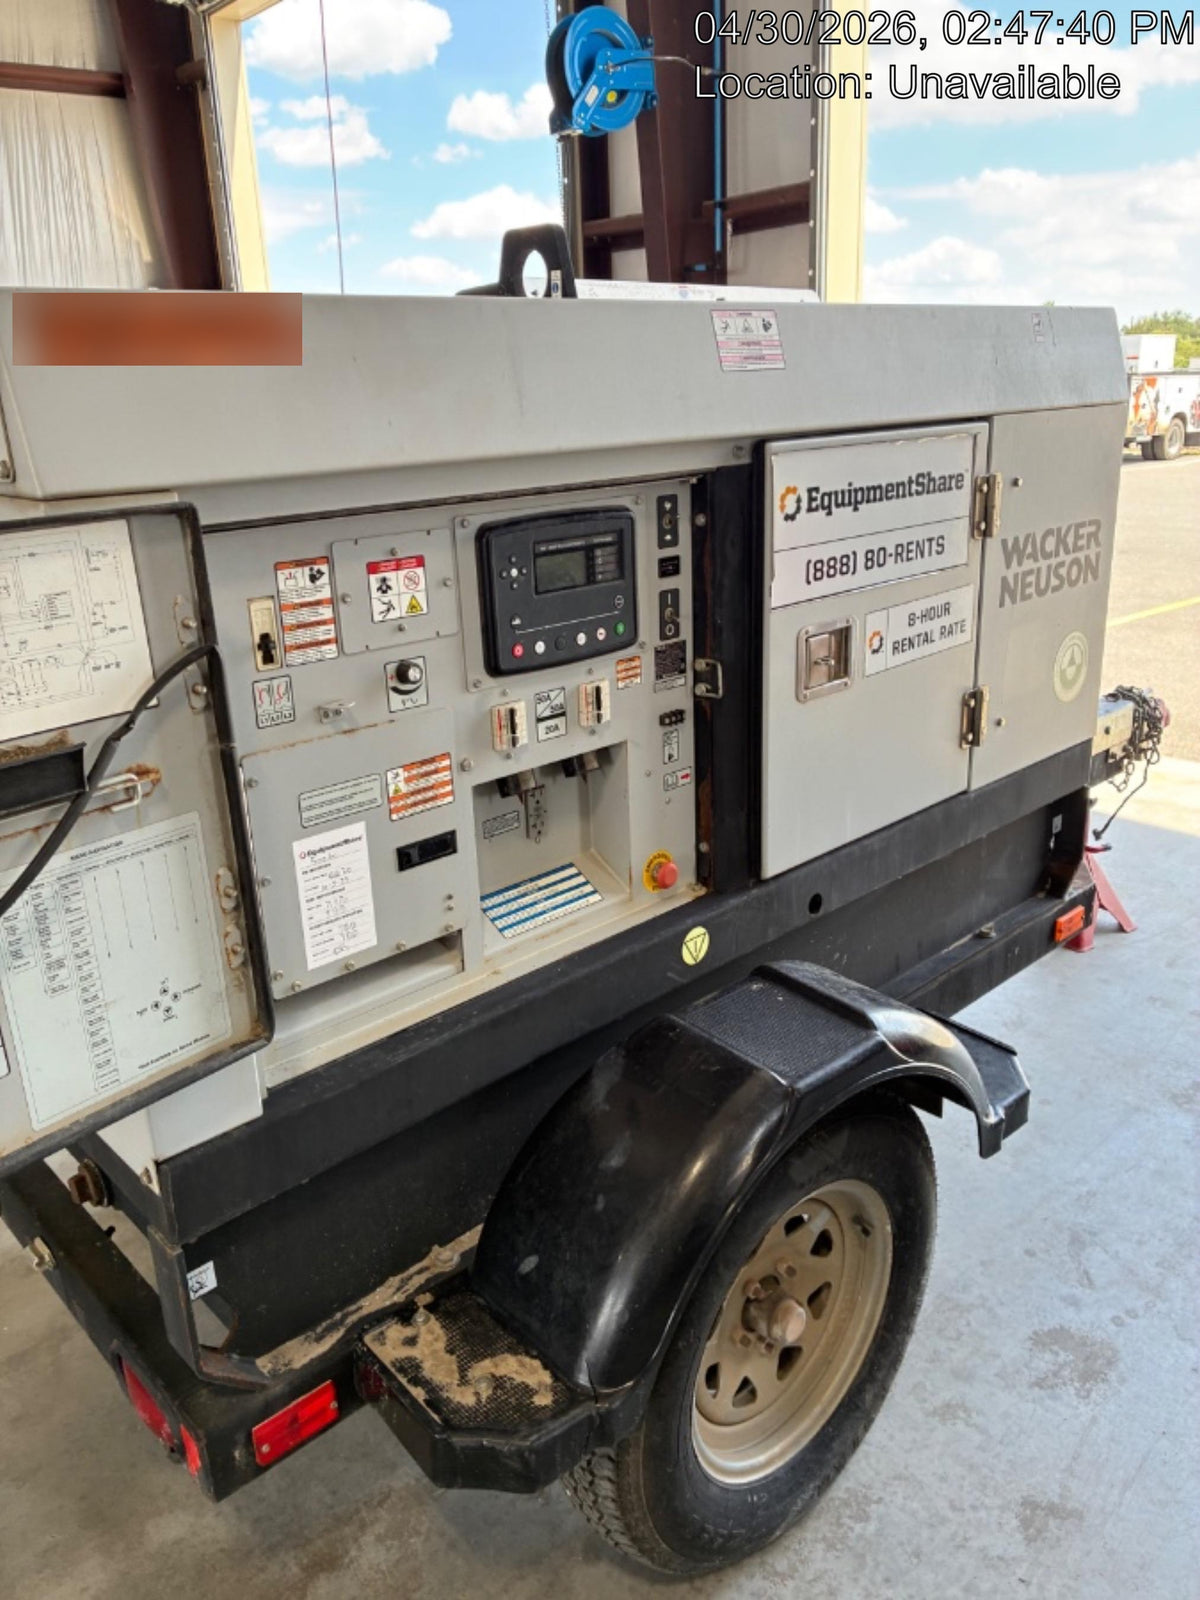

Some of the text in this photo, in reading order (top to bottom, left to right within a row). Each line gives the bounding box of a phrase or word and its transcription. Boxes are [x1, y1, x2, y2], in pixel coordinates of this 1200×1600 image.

[806, 471, 965, 516] EquipmentShare
[805, 535, 946, 585] (888) 80-RENTS
[1000, 518, 1102, 570] WACKER
[998, 551, 1102, 609] NEUSON
[892, 619, 966, 656] RENTAL RATE
[907, 601, 952, 628] 8-HOUR
